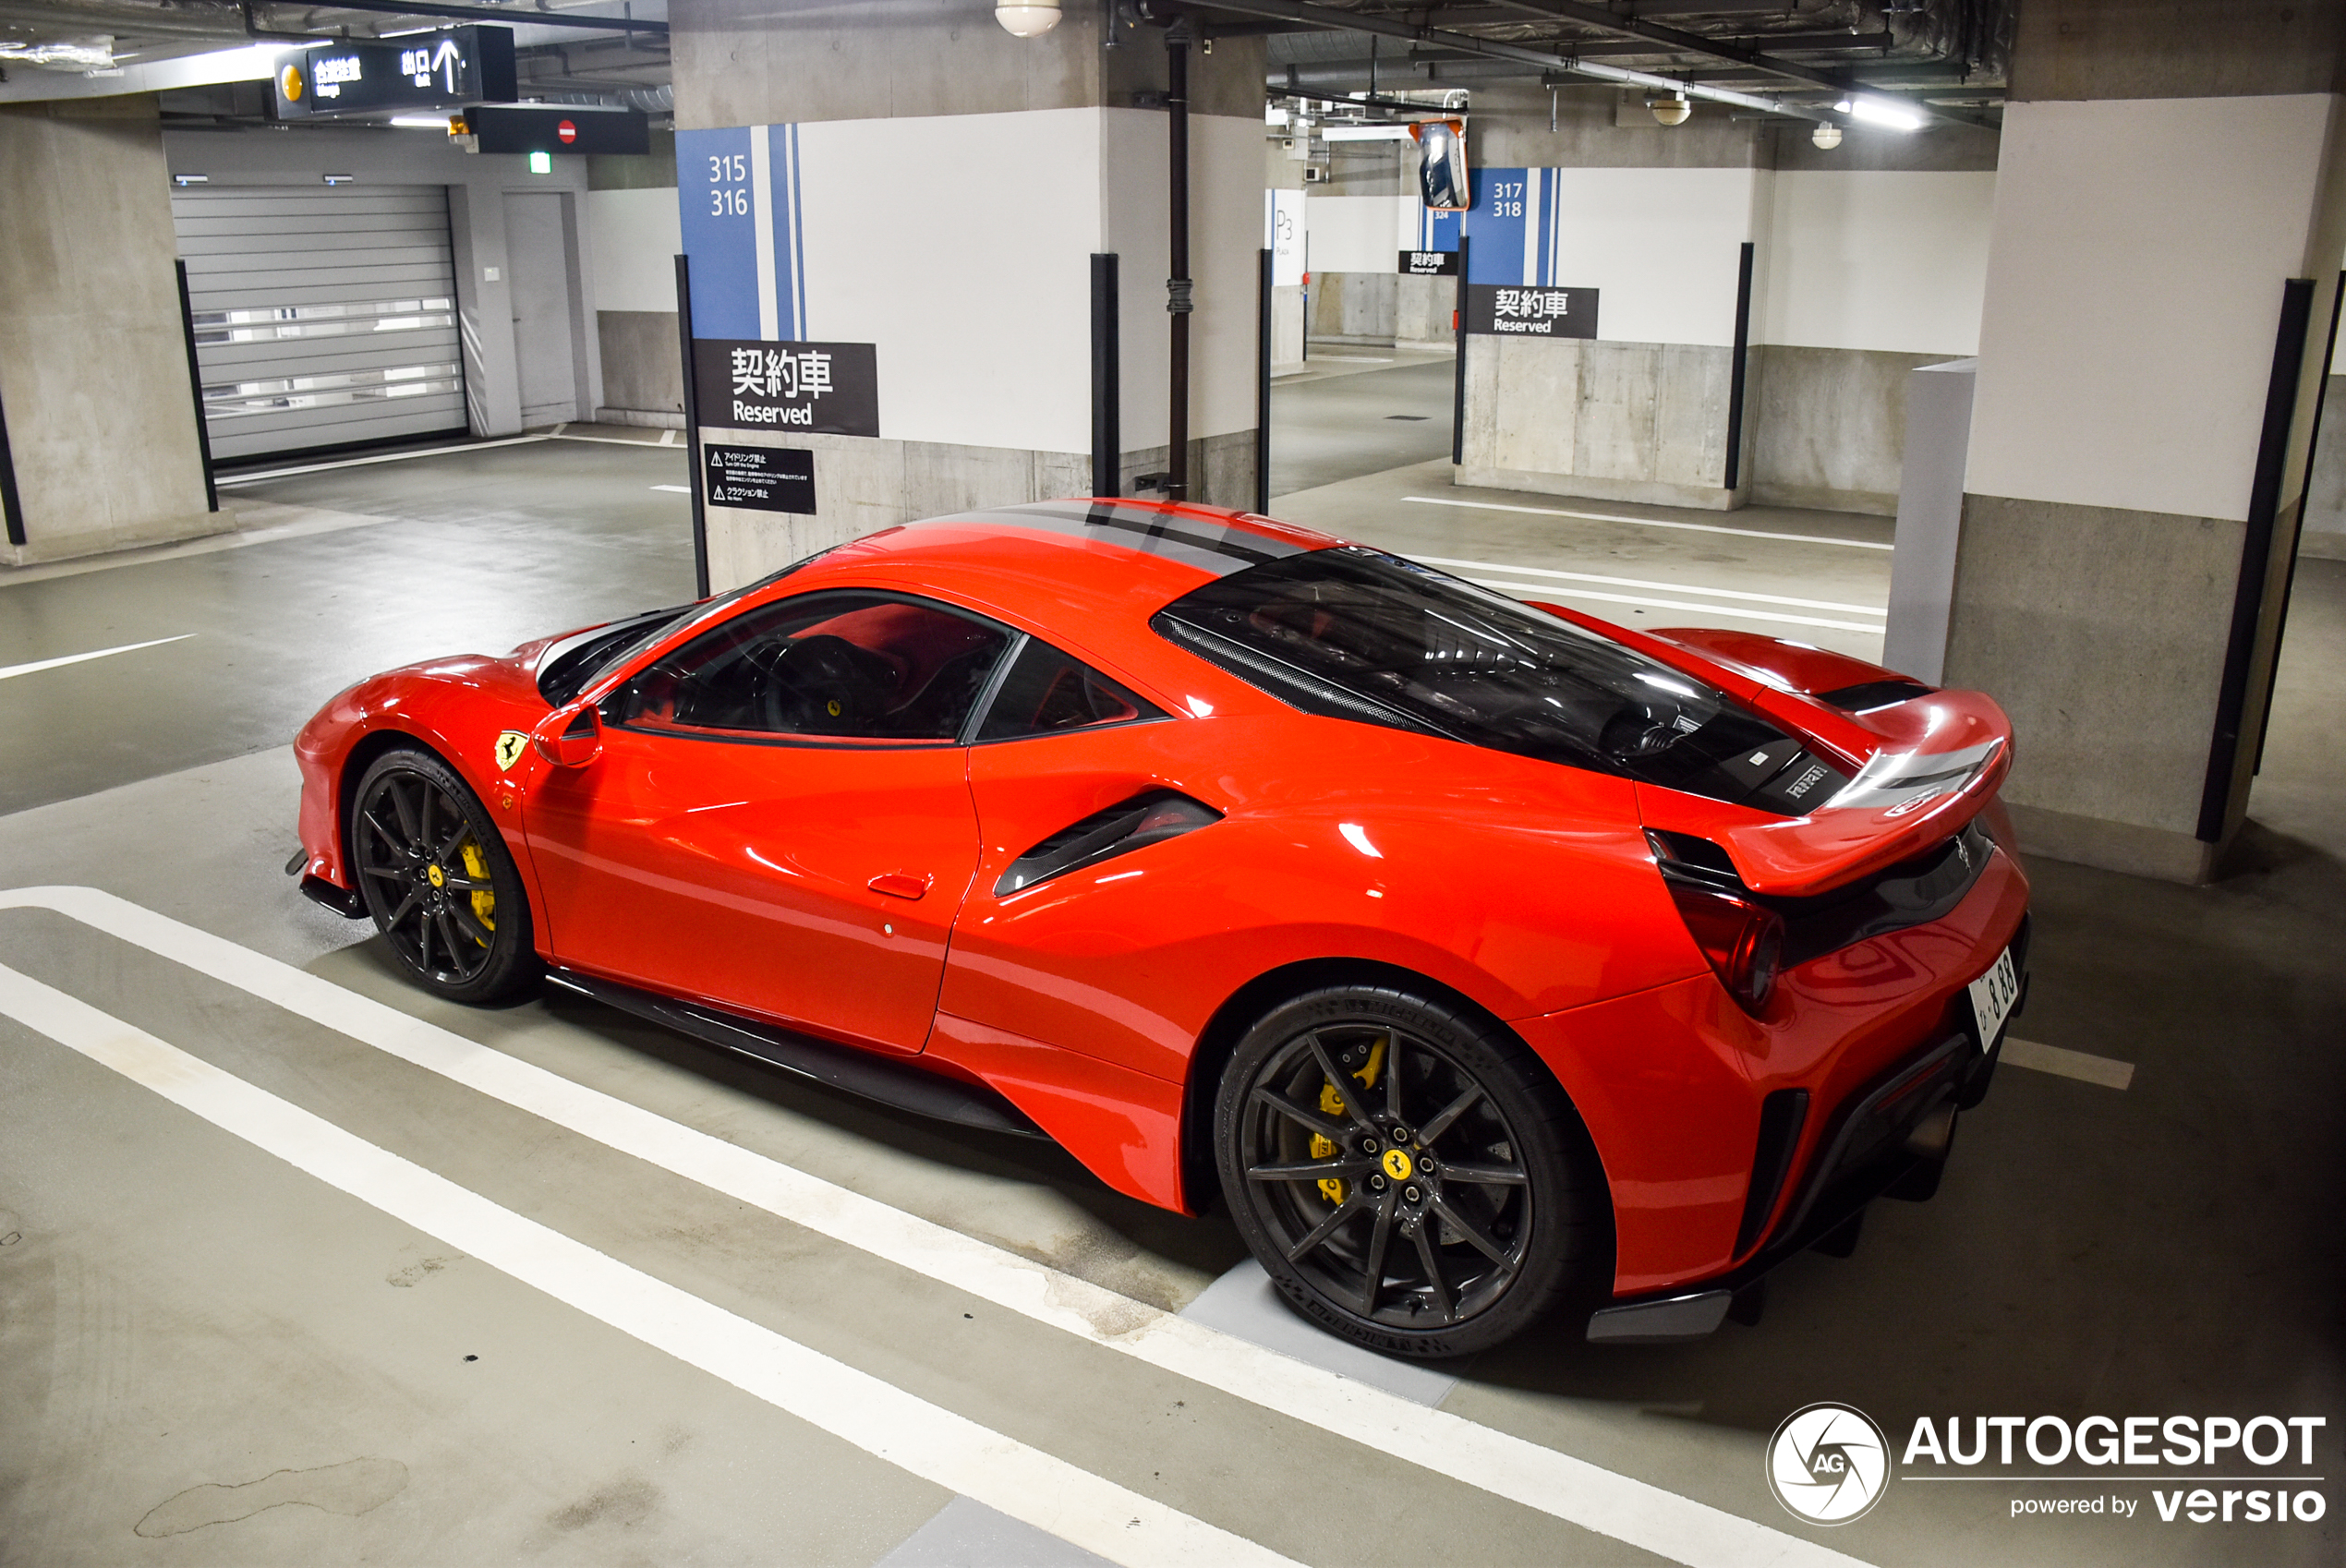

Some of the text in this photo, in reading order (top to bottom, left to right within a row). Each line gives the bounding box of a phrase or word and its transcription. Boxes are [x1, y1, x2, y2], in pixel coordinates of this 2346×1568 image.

[401, 49, 430, 76] 出口
[708, 154, 746, 183] 315
[1493, 183, 1523, 199] 317
[710, 188, 748, 216] 316
[1493, 201, 1522, 217] 318
[1276, 210, 1292, 240] P3
[1434, 211, 1449, 220] 324
[1409, 266, 1438, 274] Reserved
[1410, 252, 1445, 267] 契約車
[1494, 289, 1568, 319] 契約車
[1493, 318, 1552, 333] Reserved
[731, 347, 833, 400] 契約車
[732, 400, 813, 426] Reserved
[724, 452, 767, 464] アイドリング禁止
[727, 487, 769, 499] クラクション禁止
[1785, 765, 1828, 799] Ferrari
